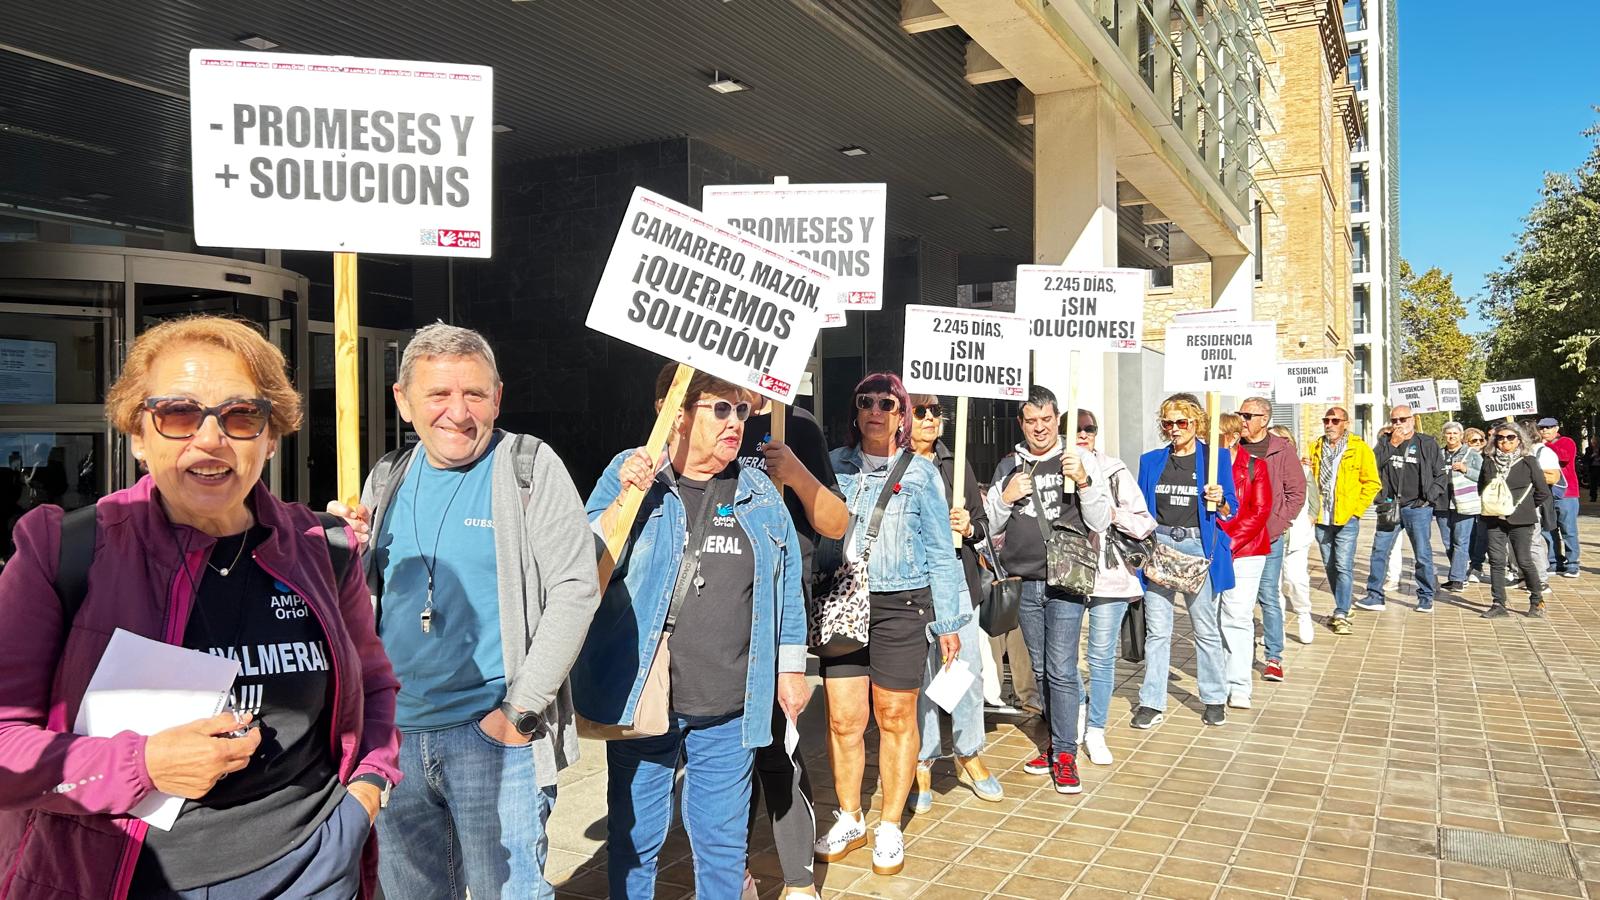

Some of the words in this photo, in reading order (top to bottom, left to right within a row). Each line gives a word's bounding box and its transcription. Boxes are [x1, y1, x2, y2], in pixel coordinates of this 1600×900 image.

[233, 103, 442, 156] PROMESES
[450, 115, 474, 157] Y
[250, 156, 470, 208] SOLUCIONS
[457, 231, 480, 239] AMPA
[860, 217, 874, 243] Y
[457, 239, 480, 248] Oriol
[630, 211, 746, 281] CAMARERO,
[749, 260, 820, 313] MAZÓN,
[1044, 276, 1080, 292] 2.245
[1083, 275, 1117, 293] DÍAS,
[632, 254, 795, 340] ¡QUEREMOS
[1061, 297, 1097, 317] ¡SIN
[627, 290, 779, 374] SOLUCIÓN!
[933, 318, 969, 335] 2.245
[972, 318, 1004, 339] DÍAS,
[950, 340, 985, 360] ¡SIN
[1186, 334, 1253, 347] RESIDENCIA
[910, 360, 1022, 386] SOLUCIONES!
[1204, 364, 1233, 381] ¡YA!
[1287, 366, 1329, 376] RESIDENCIA
[1485, 401, 1533, 412] SOLUCIONES!
[1500, 393, 1515, 402] ¡SIN
[276, 605, 308, 620] Oriol
